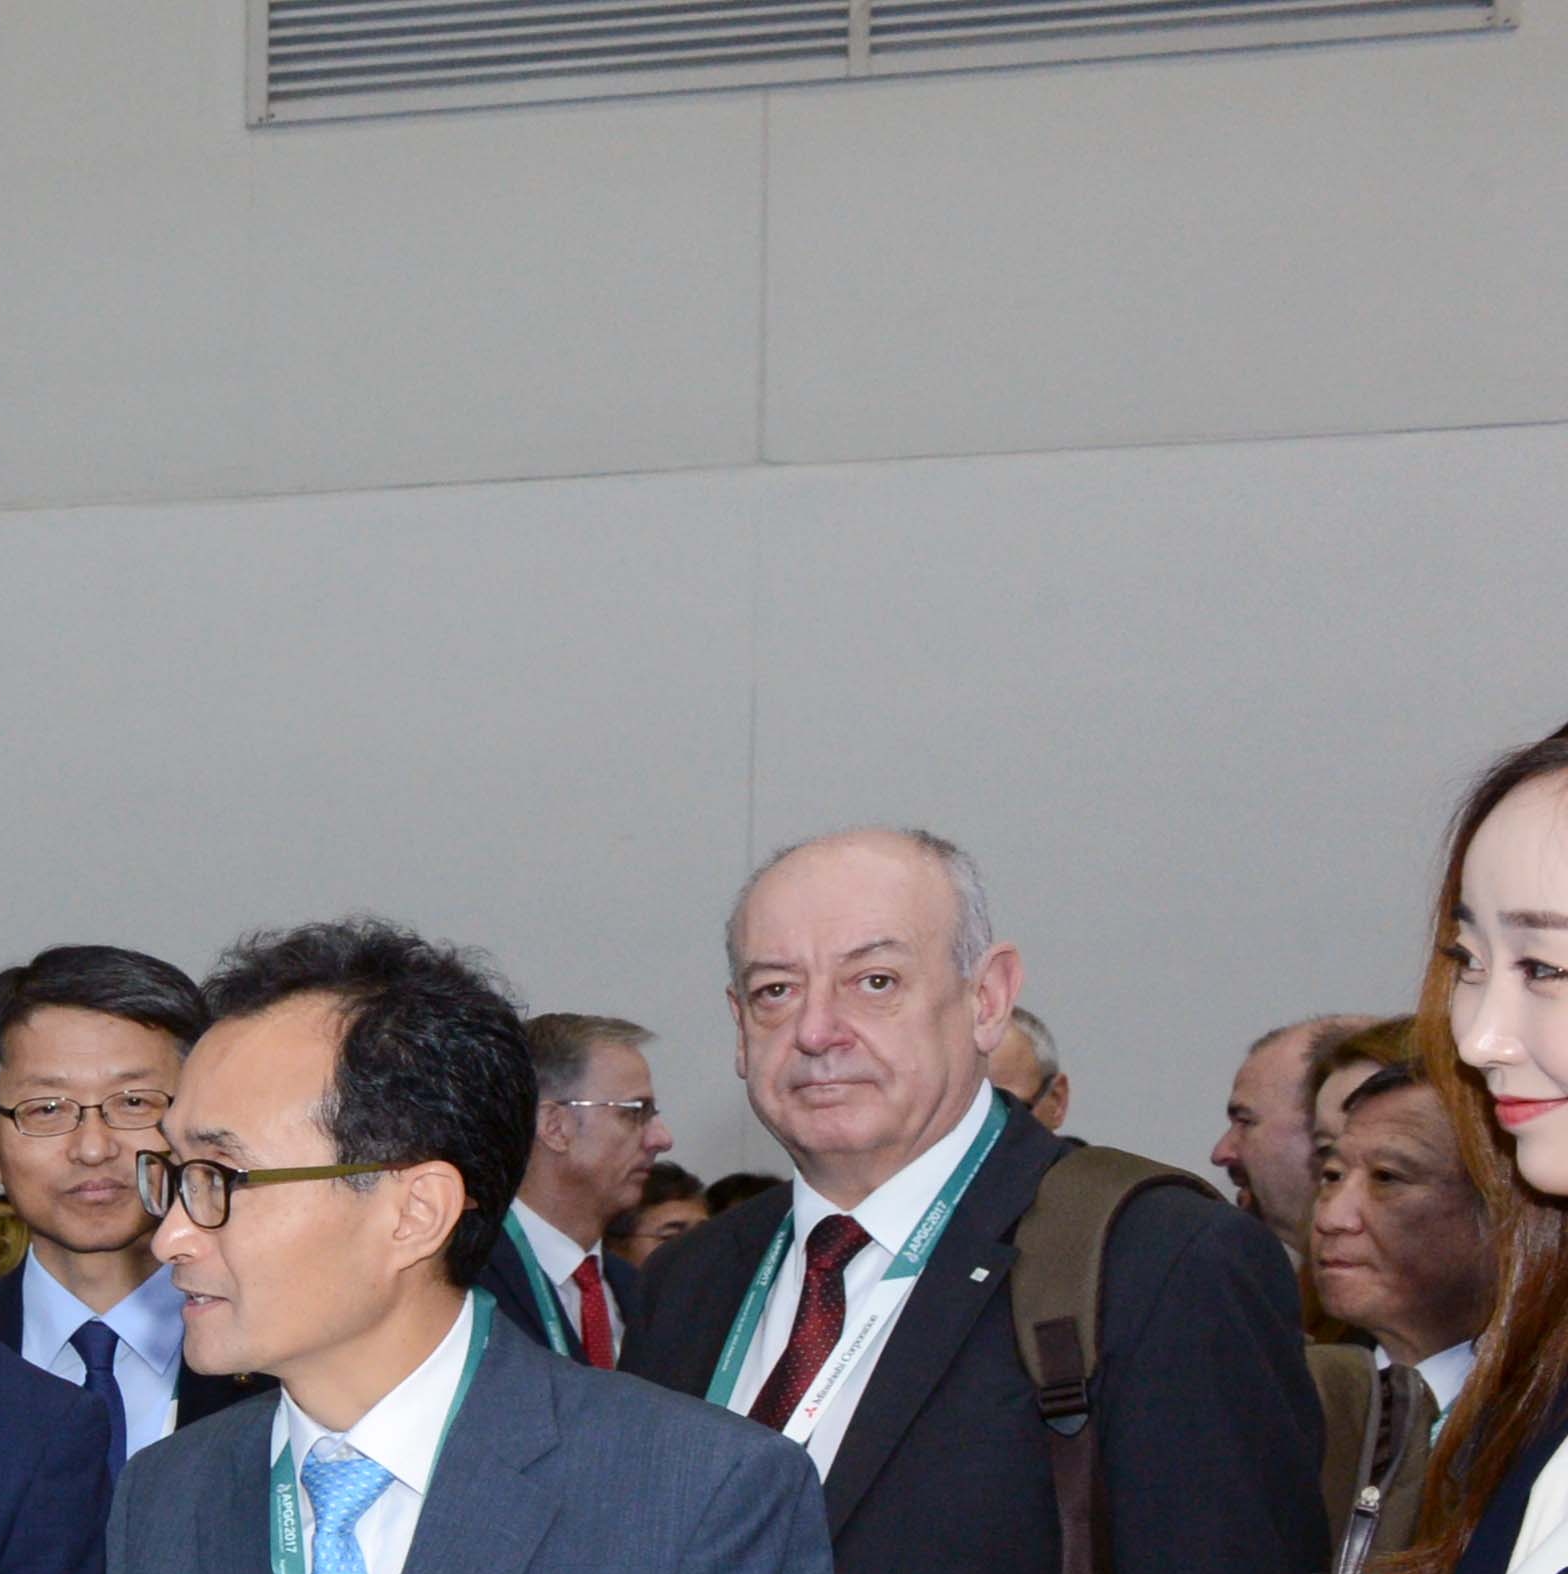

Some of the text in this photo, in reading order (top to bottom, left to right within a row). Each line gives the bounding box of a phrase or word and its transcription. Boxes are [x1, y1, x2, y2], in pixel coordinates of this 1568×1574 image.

[909, 1201, 948, 1254] APGC2017
[815, 1313, 879, 1411] Mitsubishi Corporation
[282, 1493, 297, 1553] APGC2017
